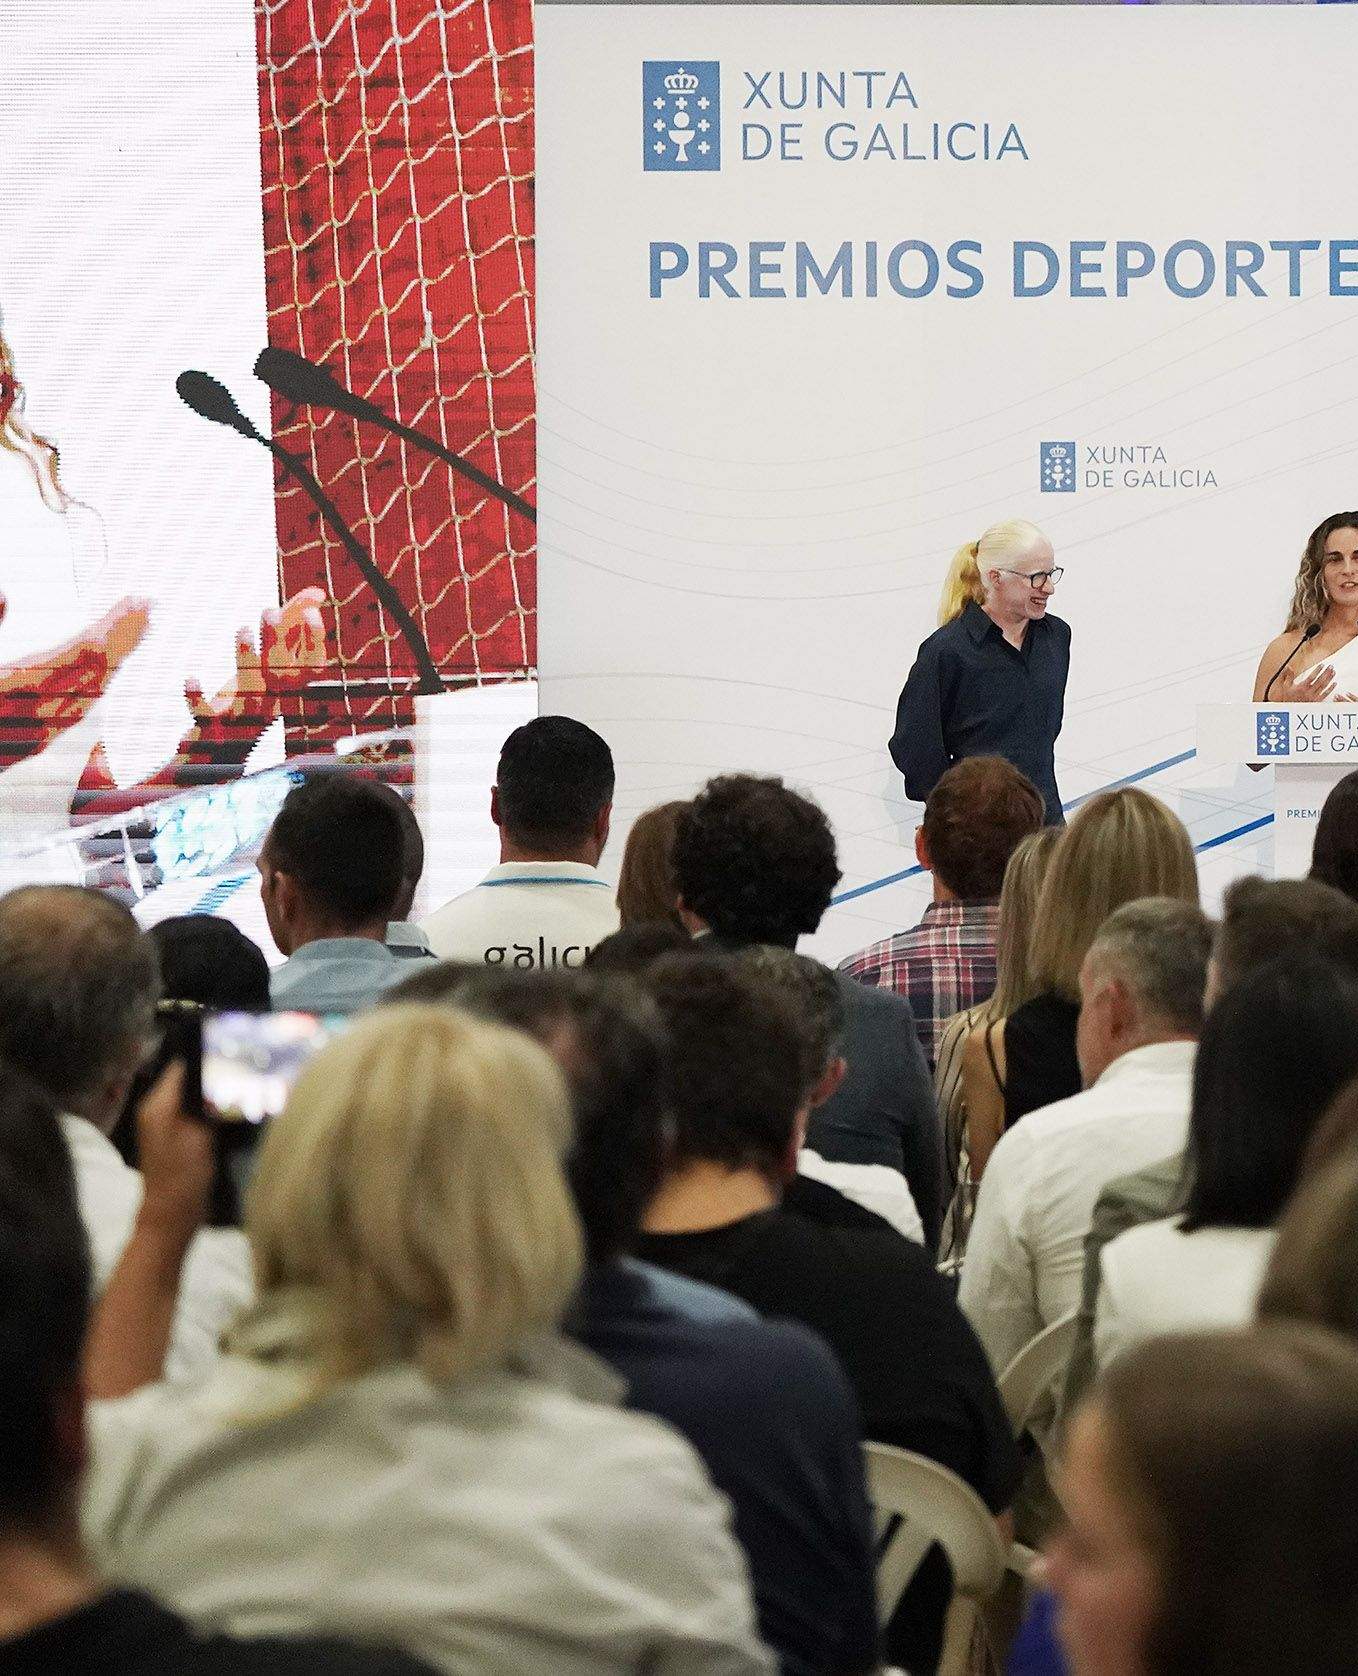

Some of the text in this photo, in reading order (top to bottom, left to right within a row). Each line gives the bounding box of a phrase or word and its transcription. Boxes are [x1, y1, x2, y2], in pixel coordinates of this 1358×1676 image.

[742, 71, 919, 109] XUNTA
[742, 122, 1029, 162] DE GALICIA
[649, 239, 985, 299] PREMIOS
[1086, 445, 1168, 465] XUNTA
[1085, 469, 1218, 488] DE GALICIA
[1295, 735, 1322, 752] DE
